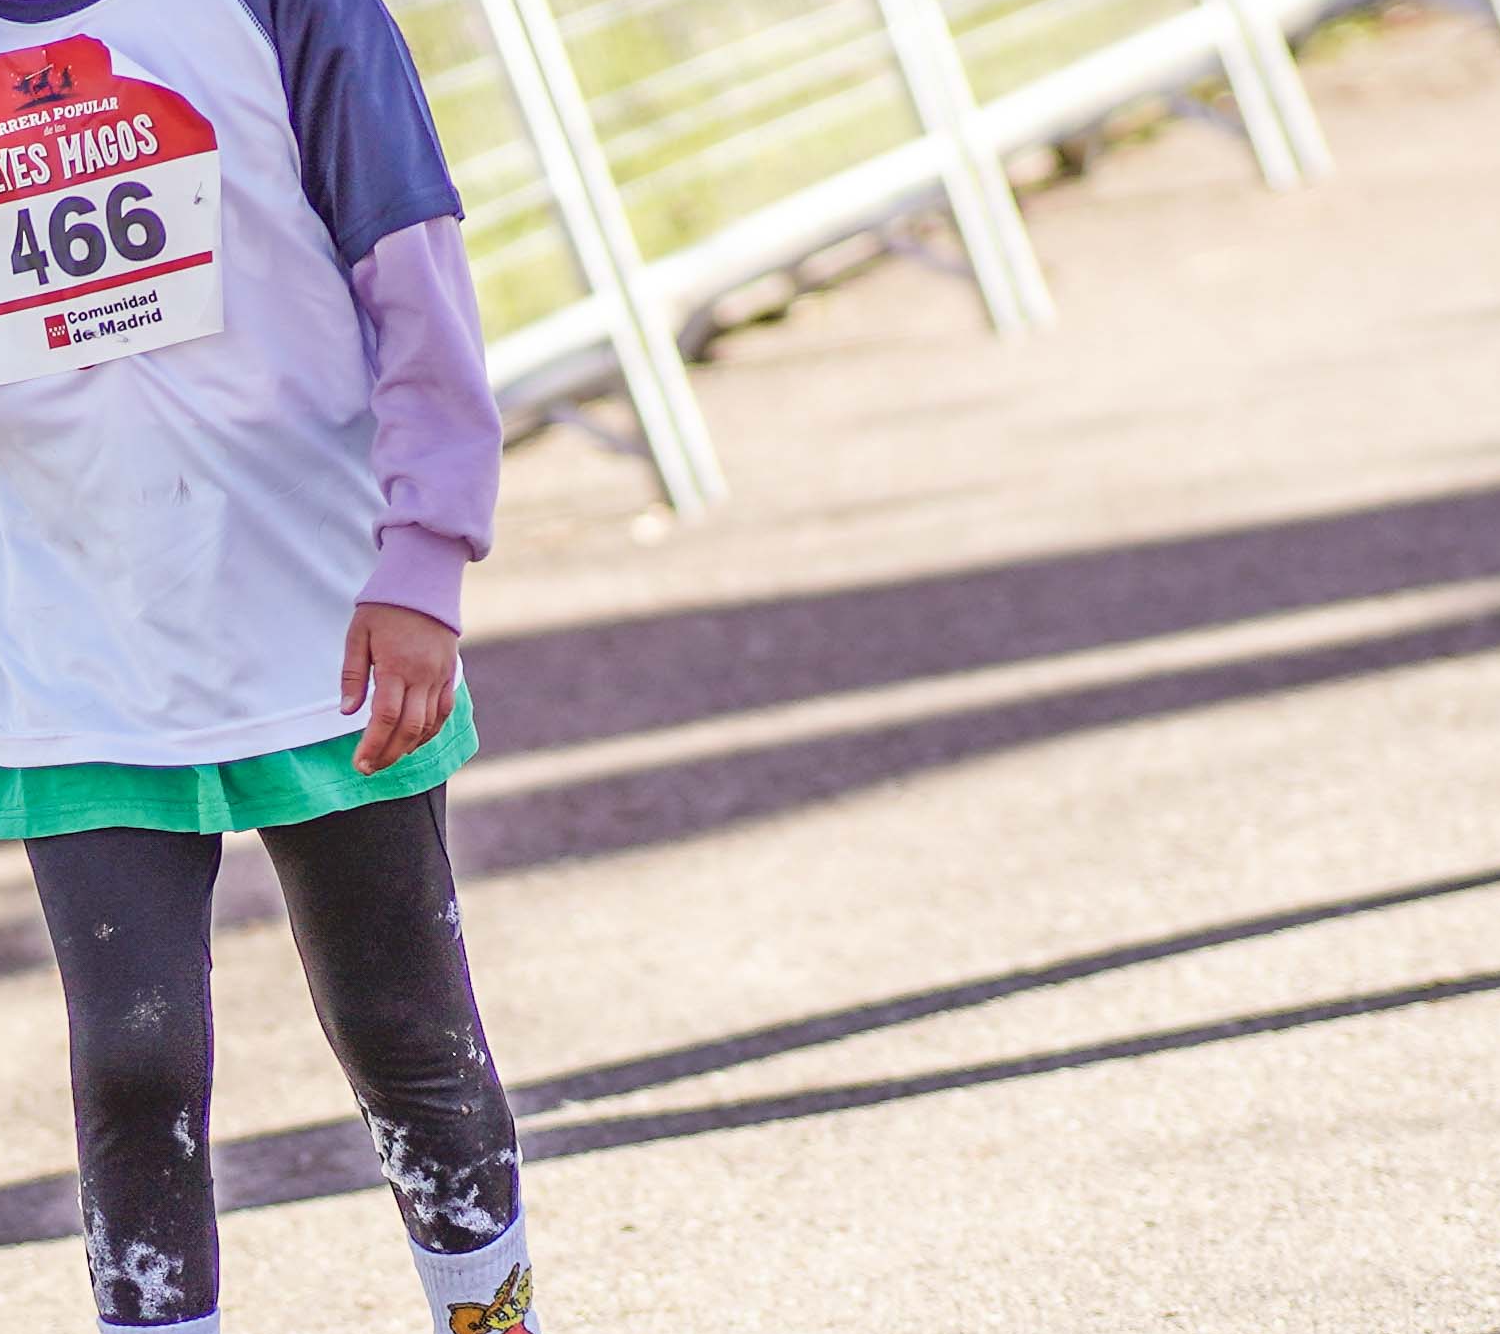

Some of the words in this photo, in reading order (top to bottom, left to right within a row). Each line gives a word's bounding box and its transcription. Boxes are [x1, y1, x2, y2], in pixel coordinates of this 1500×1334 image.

[53, 97, 119, 121] POPULAR
[58, 114, 159, 180] MAGOS
[11, 181, 167, 286] 466
[67, 290, 158, 324] Comunidad
[72, 327, 96, 344] de
[99, 308, 163, 336] Madrid
